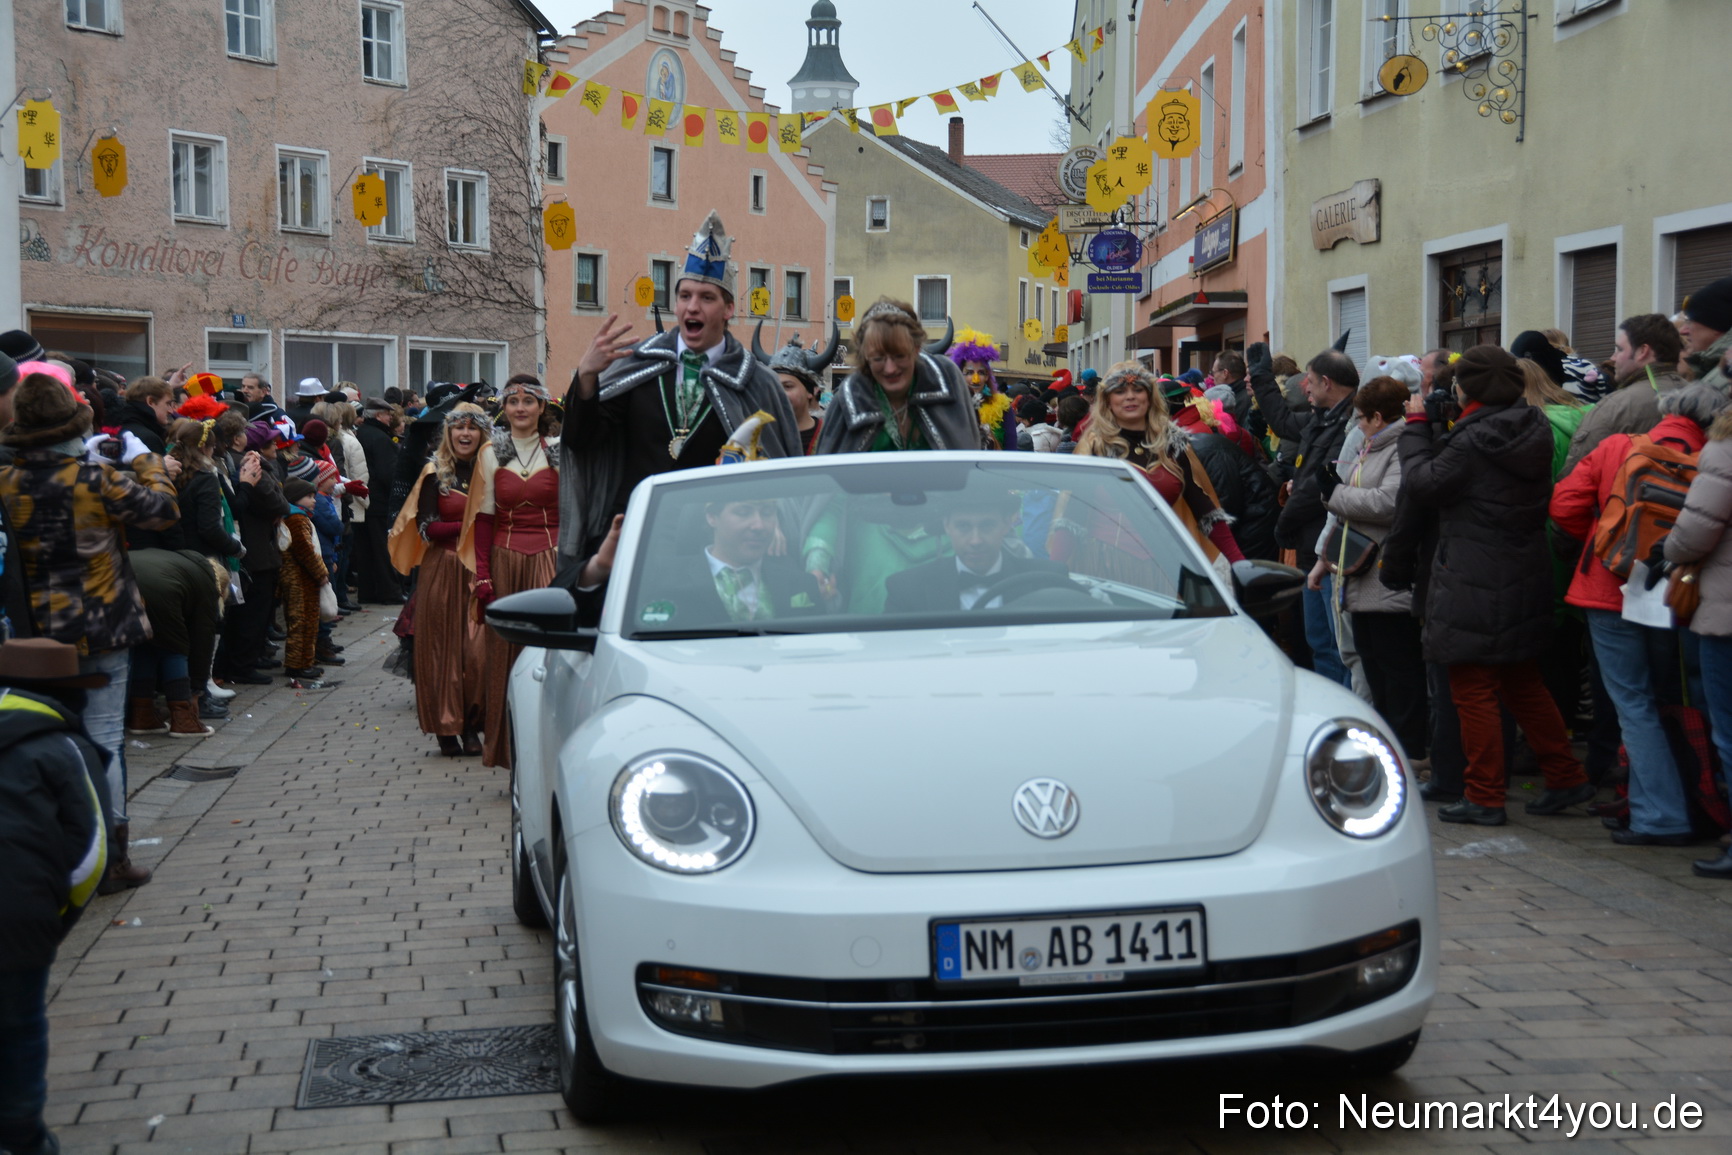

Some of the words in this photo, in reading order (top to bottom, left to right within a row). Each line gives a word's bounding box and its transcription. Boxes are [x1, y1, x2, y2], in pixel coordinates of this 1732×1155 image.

[1316, 197, 1357, 232] GALERIE
[72, 225, 226, 277] Konditorei
[239, 240, 298, 284] Cafe
[943, 957, 954, 970] D
[965, 929, 1014, 971] NM
[1047, 925, 1093, 968] AB
[1104, 918, 1197, 964] 1411
